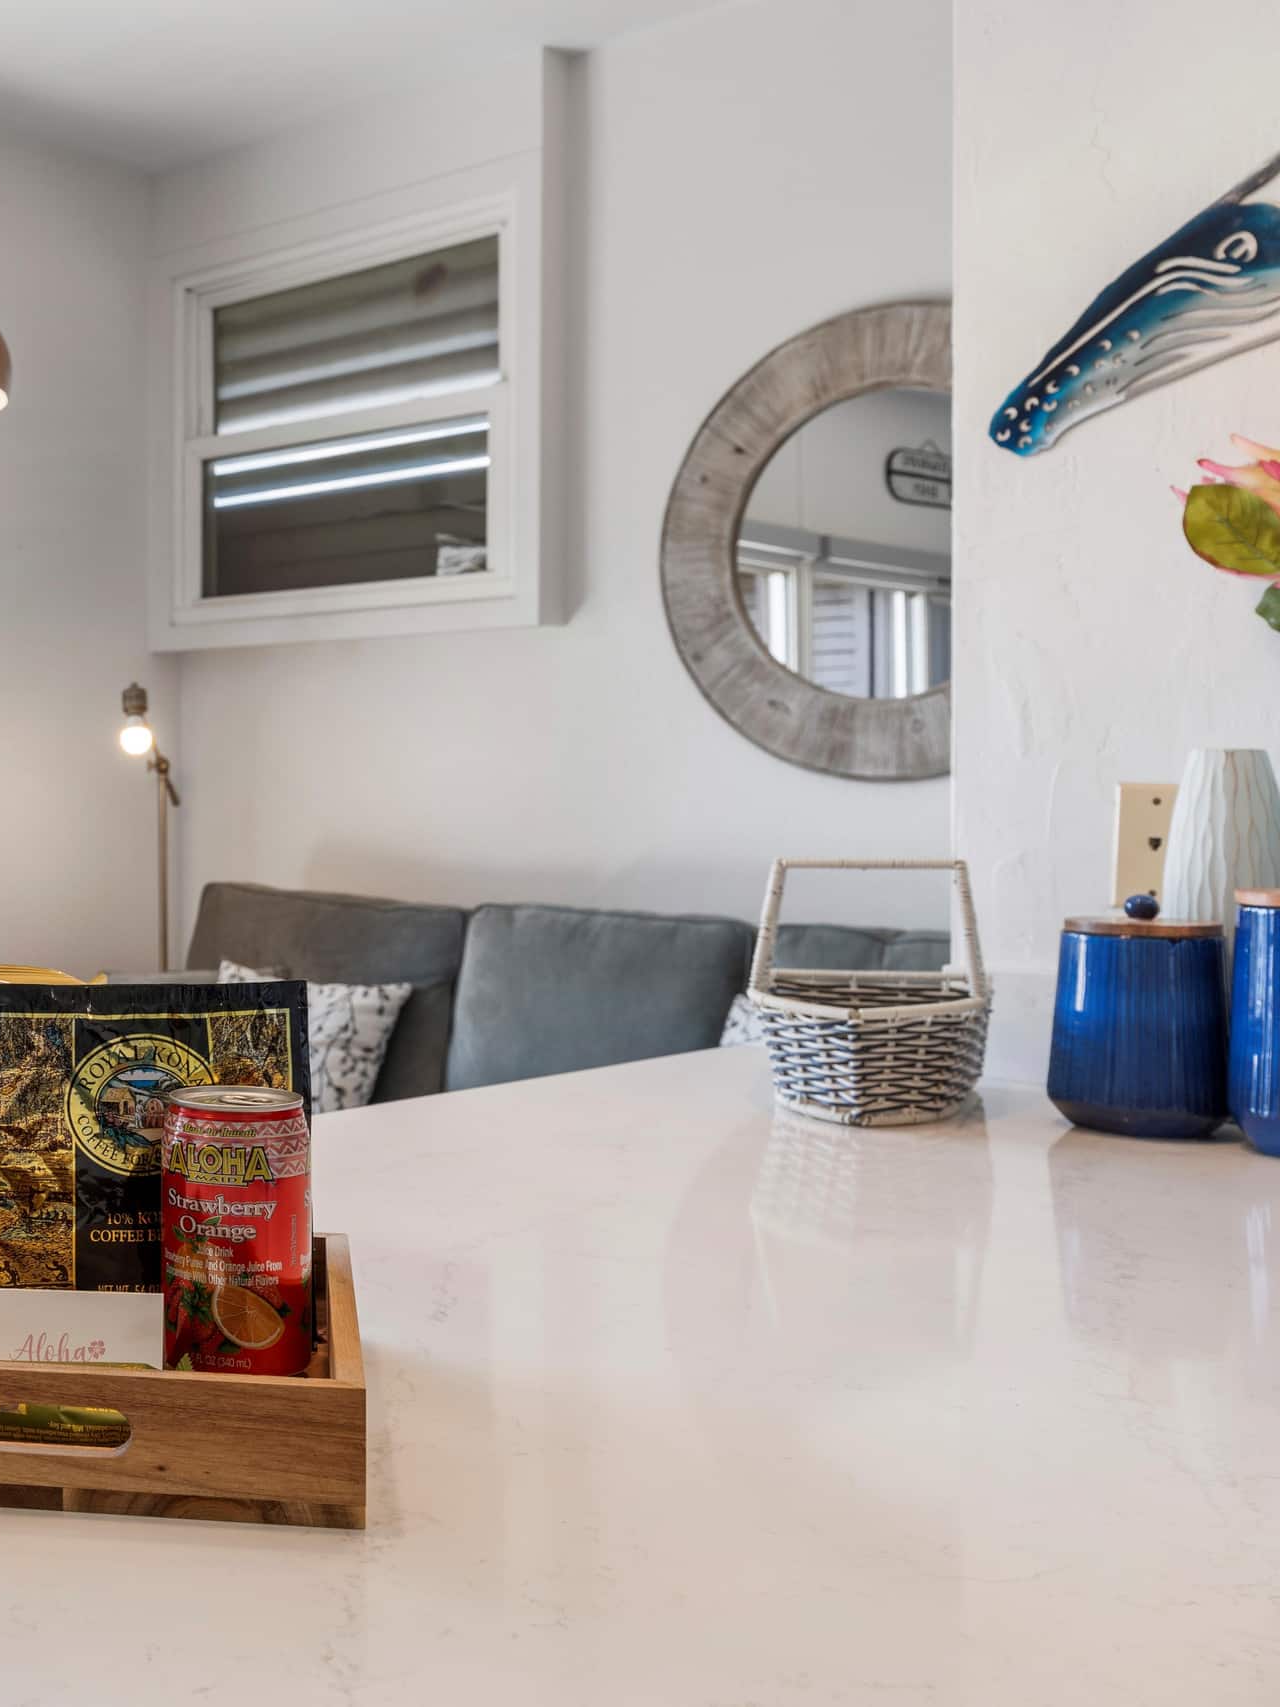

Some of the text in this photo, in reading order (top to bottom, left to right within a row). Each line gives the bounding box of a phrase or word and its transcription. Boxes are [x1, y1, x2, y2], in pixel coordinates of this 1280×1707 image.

[79, 1045, 142, 1092] ROYAL
[77, 1115, 118, 1162] COFFEE
[169, 1140, 274, 1183] ALOHA
[194, 1175, 241, 1184] MAID
[167, 1187, 277, 1221] Strawberry
[107, 1212, 134, 1225] 10%
[179, 1214, 257, 1243] Orange
[90, 1228, 144, 1242] COFFEE
[215, 1246, 234, 1258] Drink
[219, 1260, 246, 1274] Orange
[247, 1260, 265, 1272] Juice
[265, 1260, 283, 1272] From
[208, 1273, 226, 1285] Other
[229, 1272, 254, 1287] Natural
[255, 1274, 279, 1286] Flavors
[9, 1331, 87, 1362] Aloha
